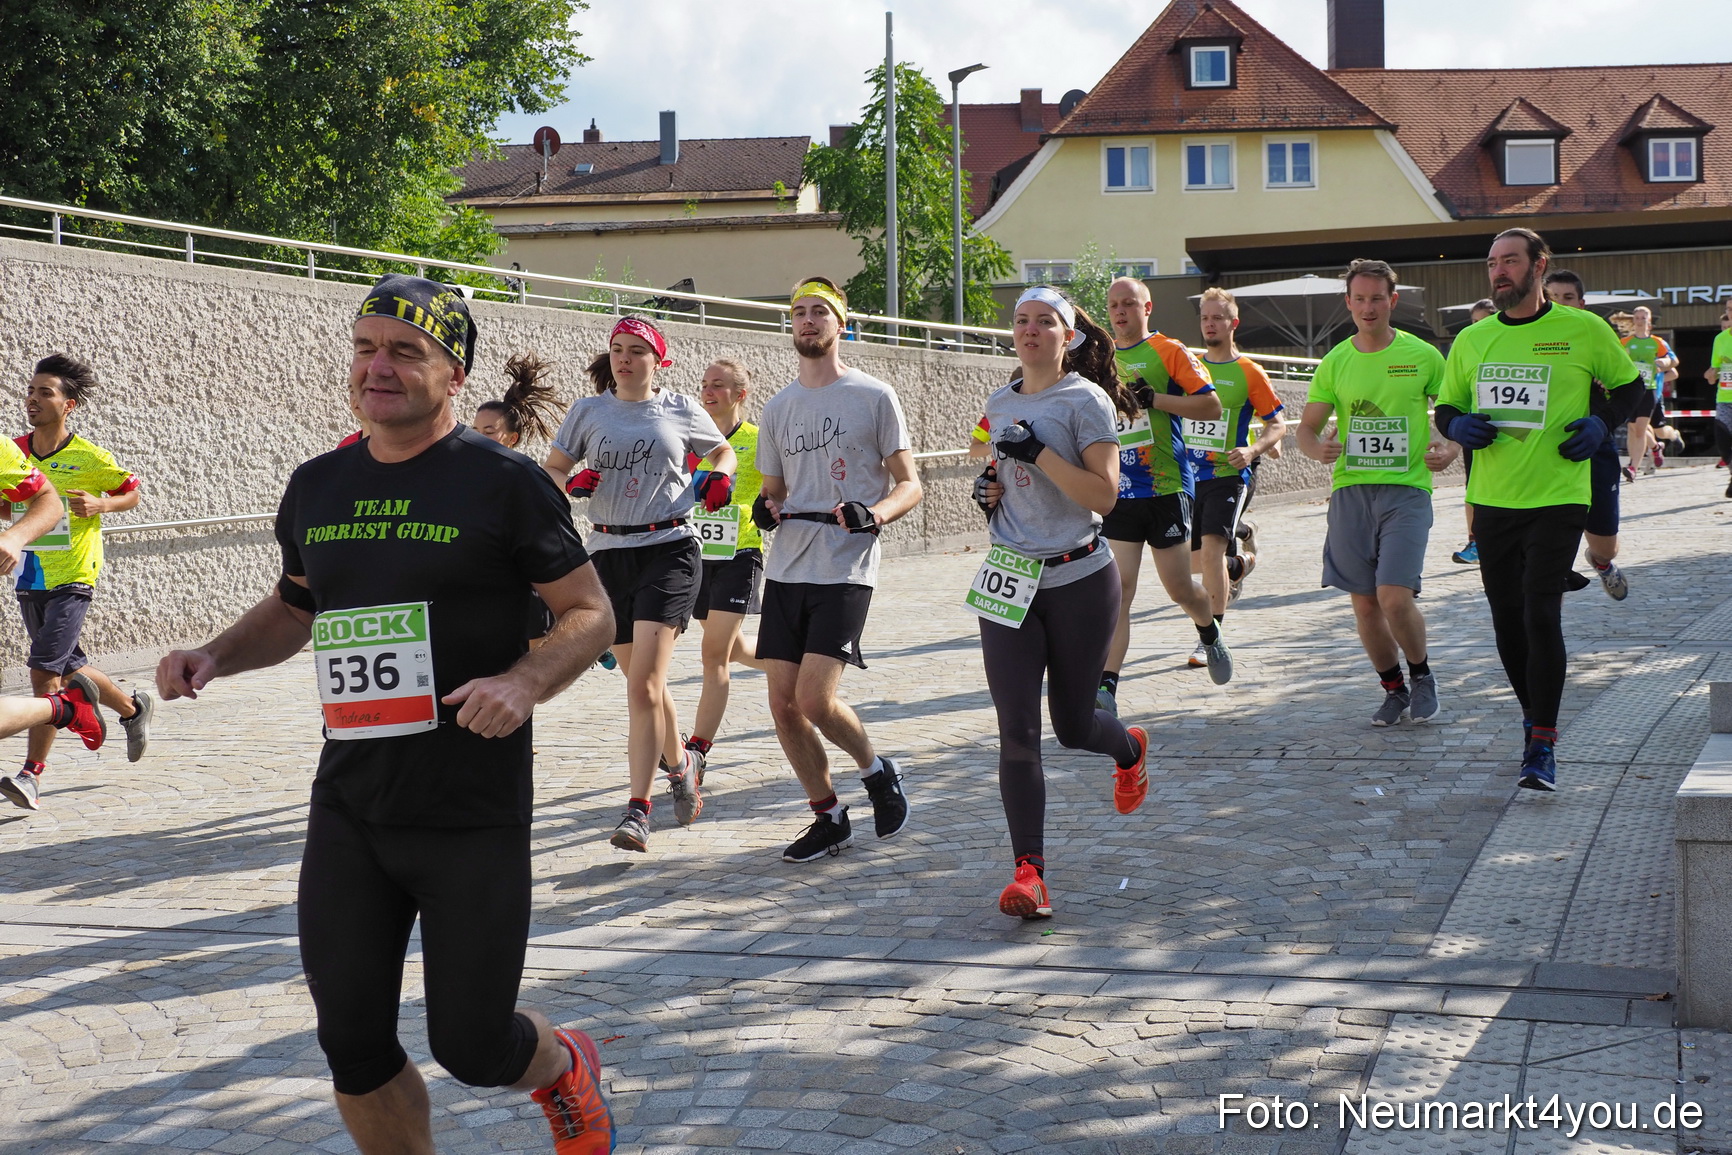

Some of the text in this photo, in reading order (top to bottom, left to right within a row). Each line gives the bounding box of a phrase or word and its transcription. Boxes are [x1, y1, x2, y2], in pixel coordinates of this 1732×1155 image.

[1481, 366, 1543, 382] BOCK
[1490, 386, 1530, 405] 194
[1190, 421, 1216, 436] 132
[1352, 419, 1403, 432] BOCK
[1188, 437, 1214, 447] DANIEL
[1359, 437, 1395, 453] 134
[1357, 458, 1395, 466] PHILLIP
[353, 499, 411, 517] TEAM
[304, 521, 460, 545] FORREST GUMP
[987, 547, 1033, 575] OCK
[981, 568, 1020, 599] 105
[974, 595, 1009, 616] SARAH
[315, 608, 417, 647] BOCK
[328, 652, 401, 695] 536
